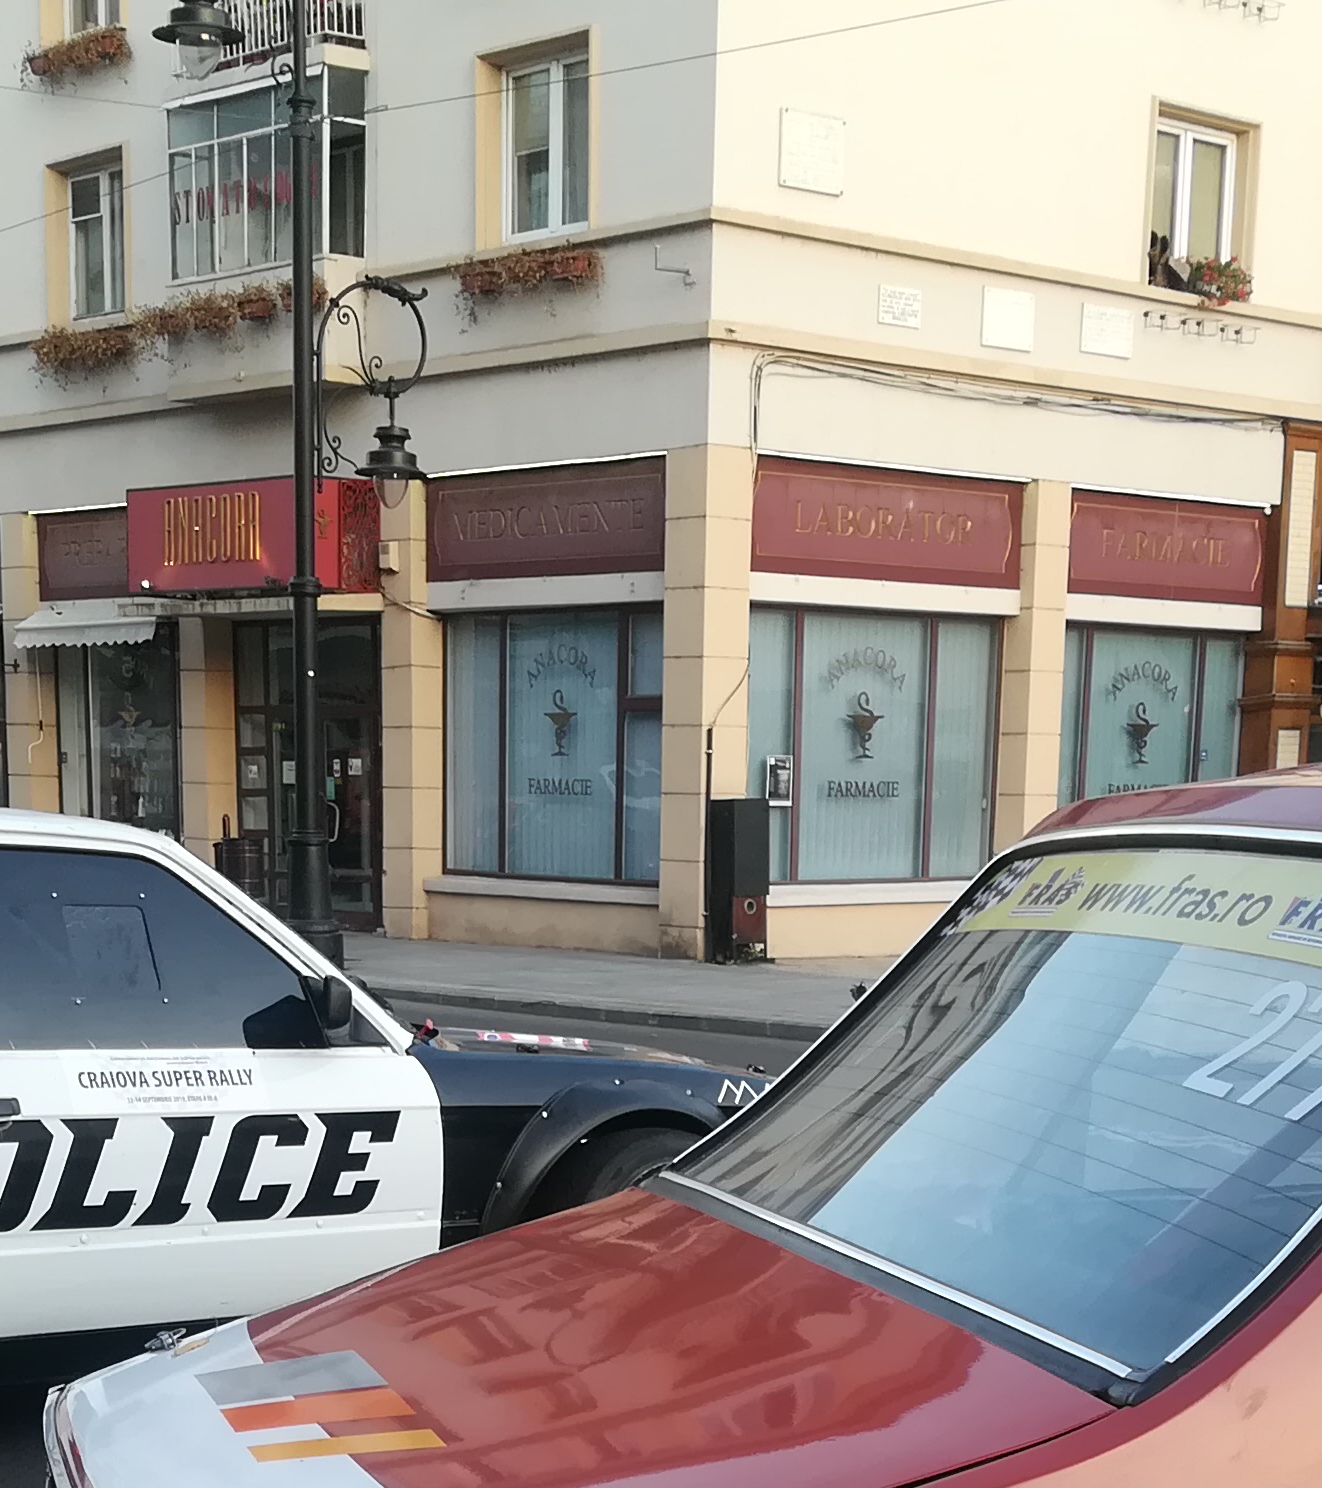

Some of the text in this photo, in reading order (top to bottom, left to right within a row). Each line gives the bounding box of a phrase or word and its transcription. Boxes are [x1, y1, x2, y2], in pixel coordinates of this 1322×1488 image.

[163, 491, 261, 566] ANACORA
[453, 498, 645, 541] MEDICAMENTE
[795, 500, 973, 546] LABORATOR
[1101, 528, 1231, 567] FARMACIE
[527, 644, 596, 688] ANACORA
[827, 647, 906, 692] ANACORA
[1111, 661, 1179, 702] ANACORA
[528, 778, 593, 796] FARMACIE
[827, 781, 899, 798] FARMACIE
[1078, 875, 1274, 926] www.fras.ro
[78, 1068, 253, 1088] CRAIOVA SUPER RALLY
